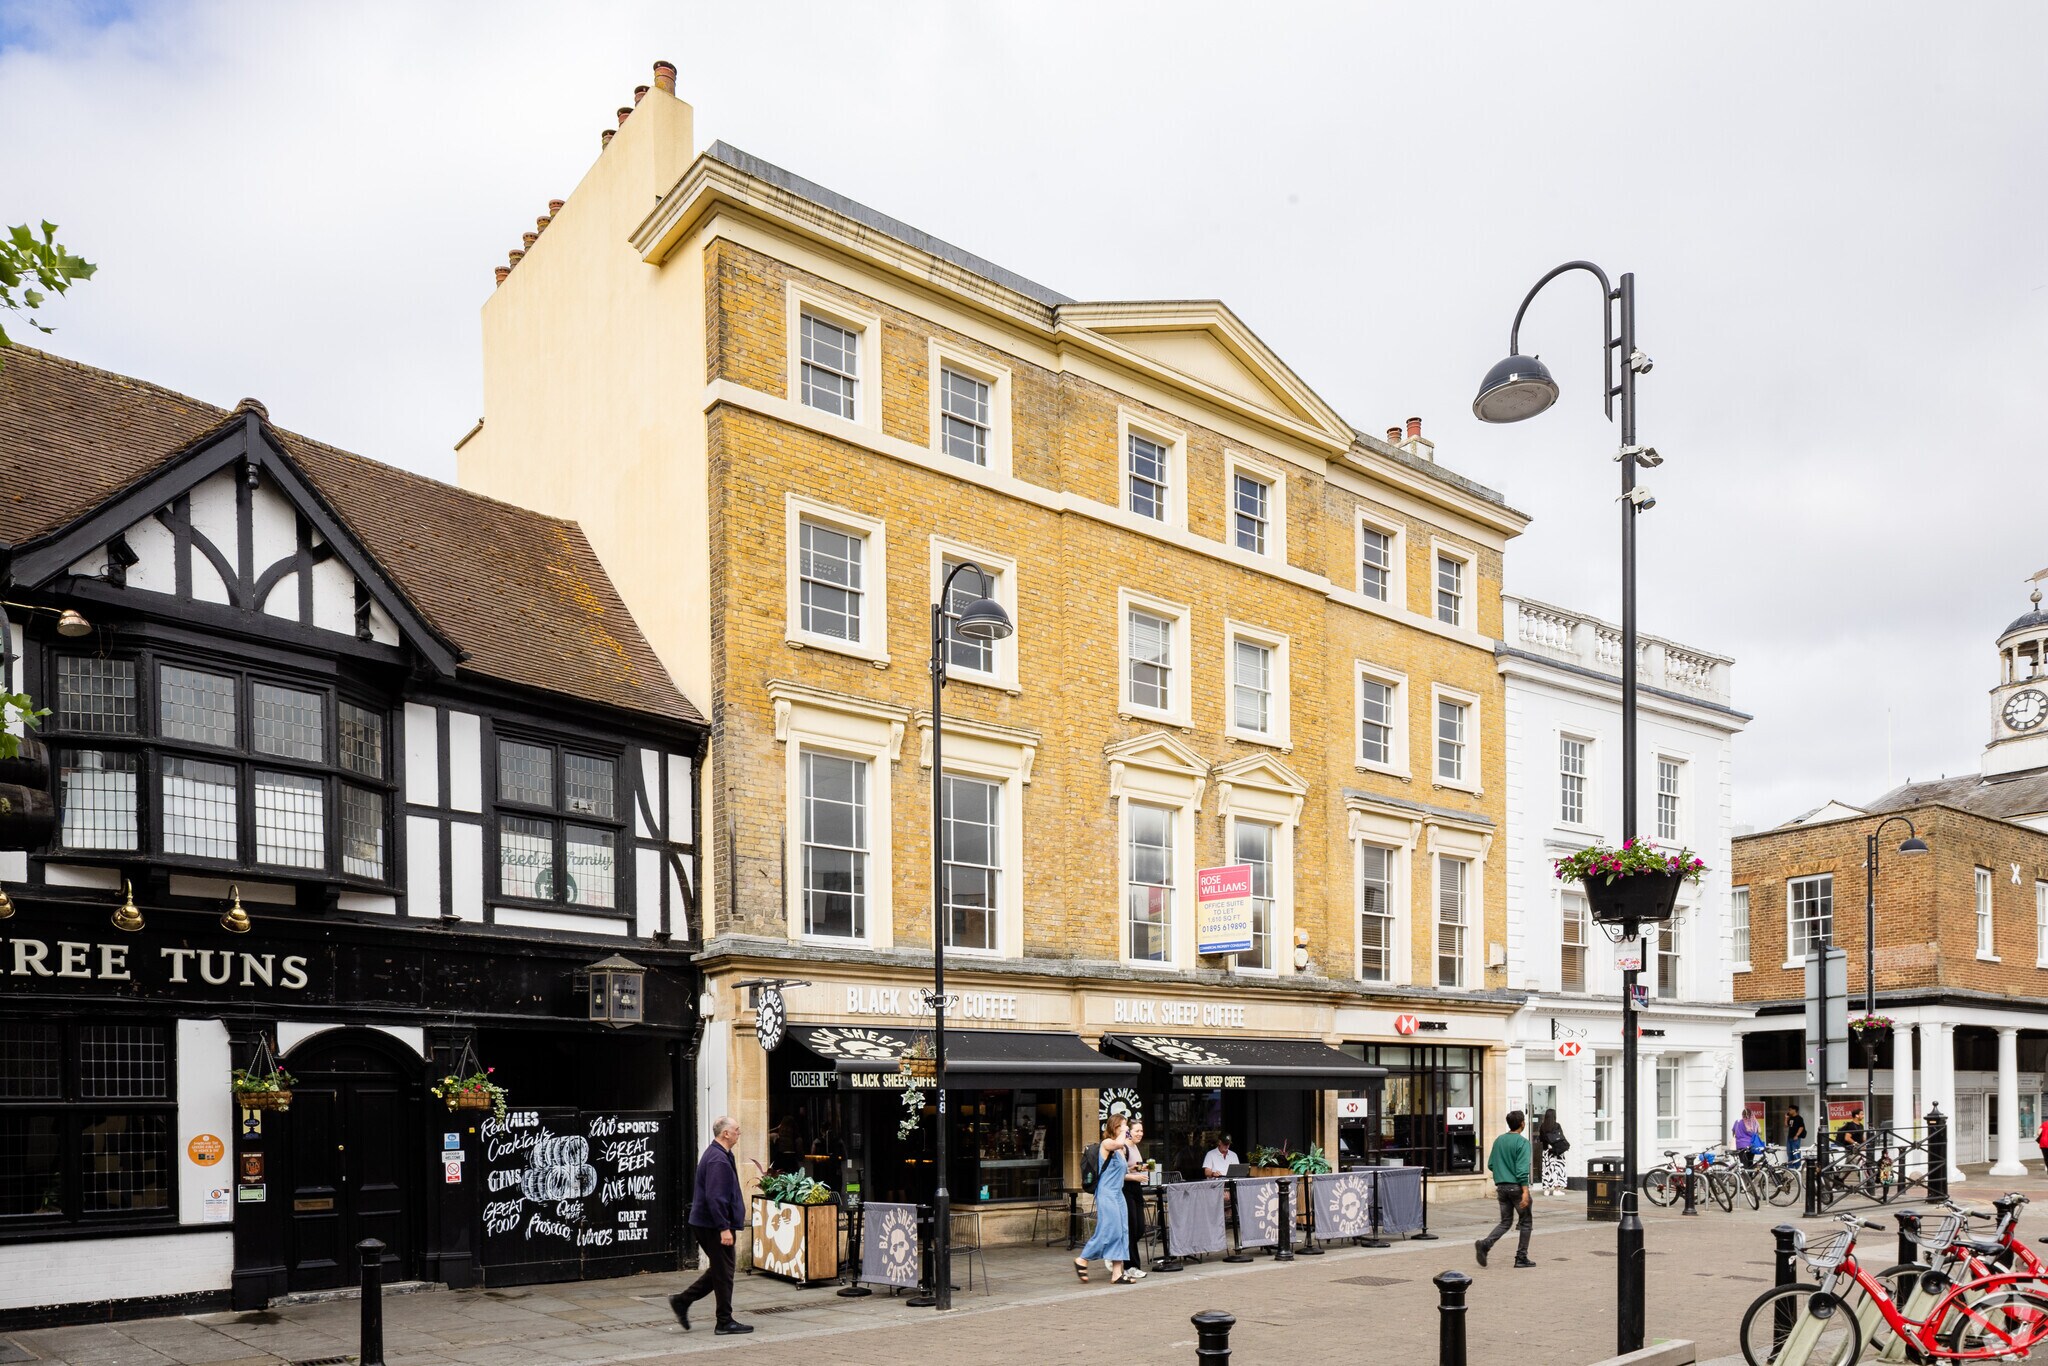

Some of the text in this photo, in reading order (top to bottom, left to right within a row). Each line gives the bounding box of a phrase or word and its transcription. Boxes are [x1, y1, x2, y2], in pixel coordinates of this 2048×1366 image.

[1201, 875, 1221, 886] ROSE
[1201, 882, 1247, 894] WILLIAMS
[1204, 901, 1225, 909] OFFICE
[1202, 922, 1247, 932] 01895 619890
[0, 937, 309, 990] REE TUNS
[846, 986, 901, 1015] BLACK
[963, 993, 1017, 1020] COFFEE
[1114, 1000, 1245, 1028] BLACK SHEEP COFFEE
[839, 1028, 906, 1047] SHEEP
[791, 1072, 820, 1087] ORDER
[852, 1073, 880, 1088] BLACK
[882, 1075, 909, 1088] SHEEP
[1182, 1075, 1246, 1088] BLACK SHEEP COFFEE
[1099, 1087, 1142, 1120] BLACK SHEEP
[481, 1112, 539, 1143] Real ALES
[617, 1121, 659, 1134] SPORTS
[488, 1126, 555, 1162] Cocktails
[606, 1137, 650, 1161] GREAT
[618, 1151, 655, 1173] BEER
[488, 1168, 522, 1192] GINS
[602, 1179, 626, 1203] LIVE
[1255, 1182, 1274, 1217] BLACK
[1329, 1177, 1348, 1211] BLACK
[483, 1197, 527, 1221] GREAT
[618, 1210, 647, 1222] CRAFT
[486, 1213, 520, 1237] FOOD
[526, 1212, 572, 1239] Prosecco
[618, 1228, 648, 1241] DRAFT
[879, 1210, 897, 1249] BLACK
